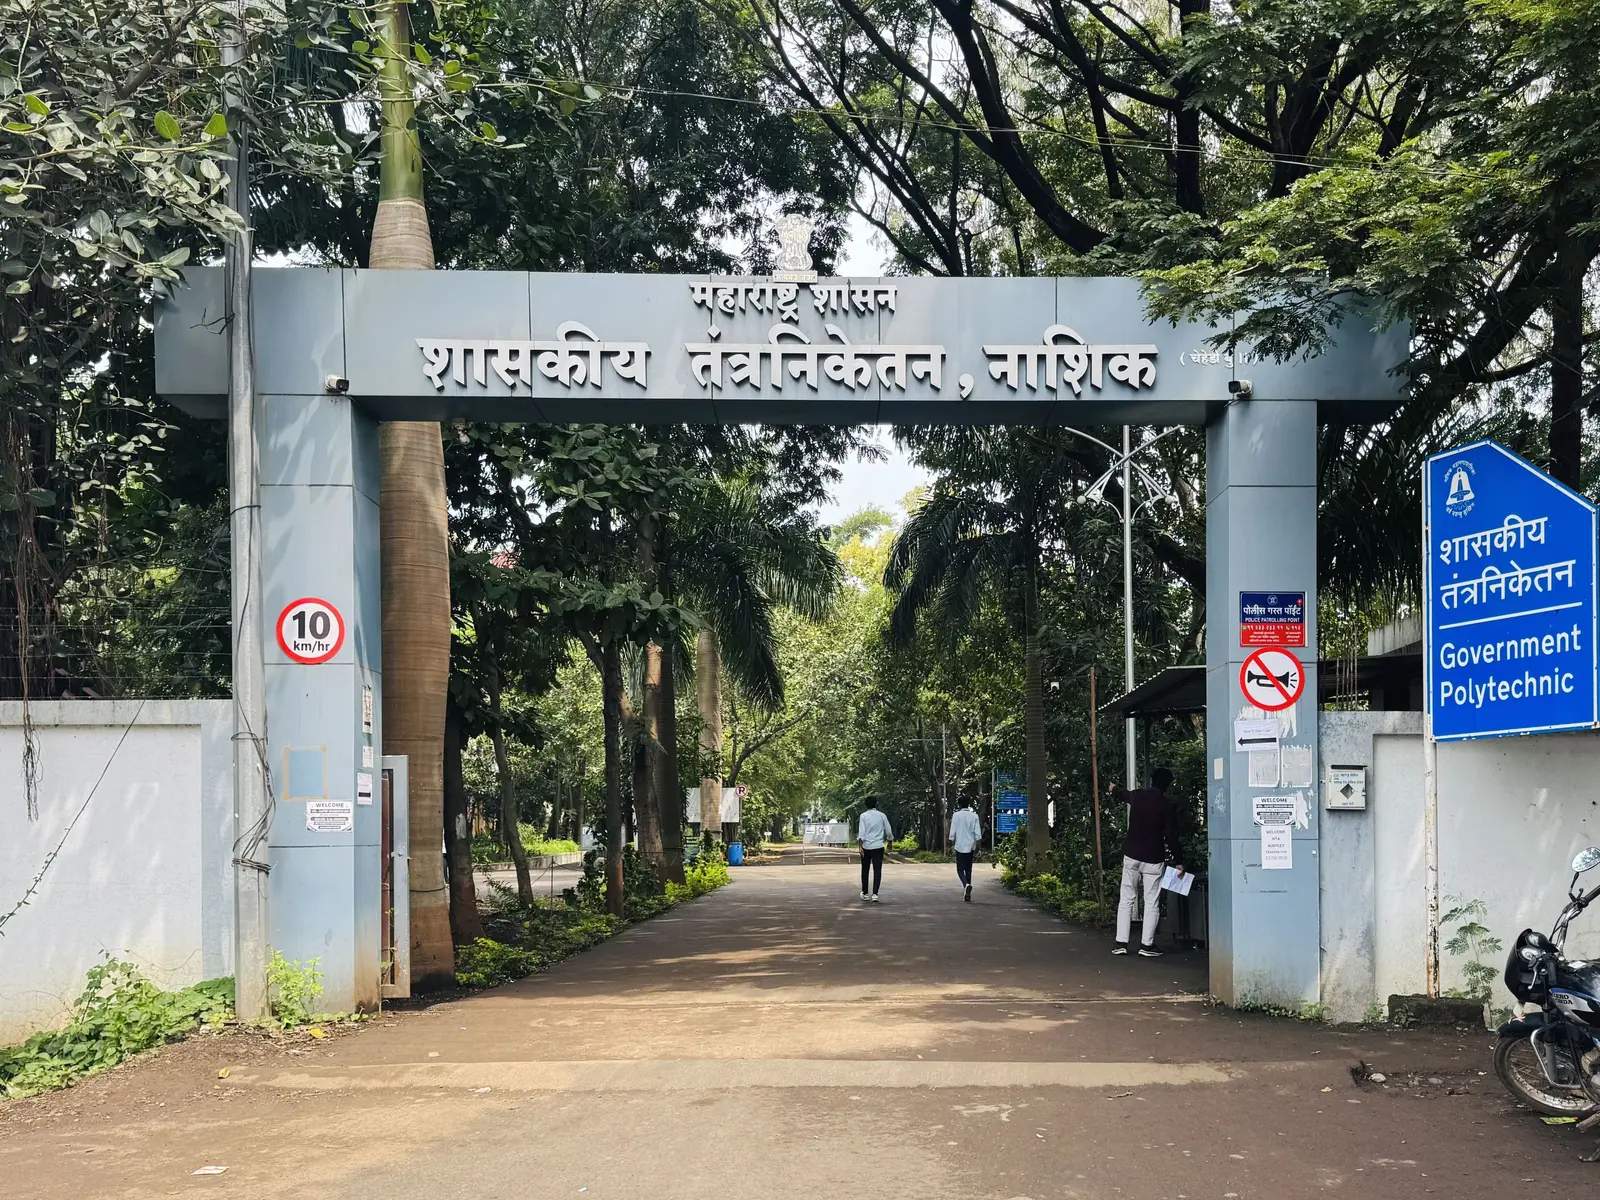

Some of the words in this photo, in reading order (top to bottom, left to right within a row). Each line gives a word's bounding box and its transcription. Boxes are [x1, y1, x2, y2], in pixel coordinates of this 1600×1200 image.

[688, 281, 800, 322] महाराष्ट्र
[809, 281, 898, 318] शासन
[415, 320, 652, 391] शासकीय
[982, 324, 1159, 395] नाशिक
[1440, 514, 1548, 565] शासकीय
[1440, 560, 1576, 609] तंत्रनिकेतन
[292, 610, 331, 640] 10
[1243, 605, 1266, 615] पोलीस
[1267, 607, 1283, 615] गस्त
[293, 640, 331, 652] km/hr
[1440, 624, 1581, 670] Government
[1440, 667, 1574, 709] Polytechnic
